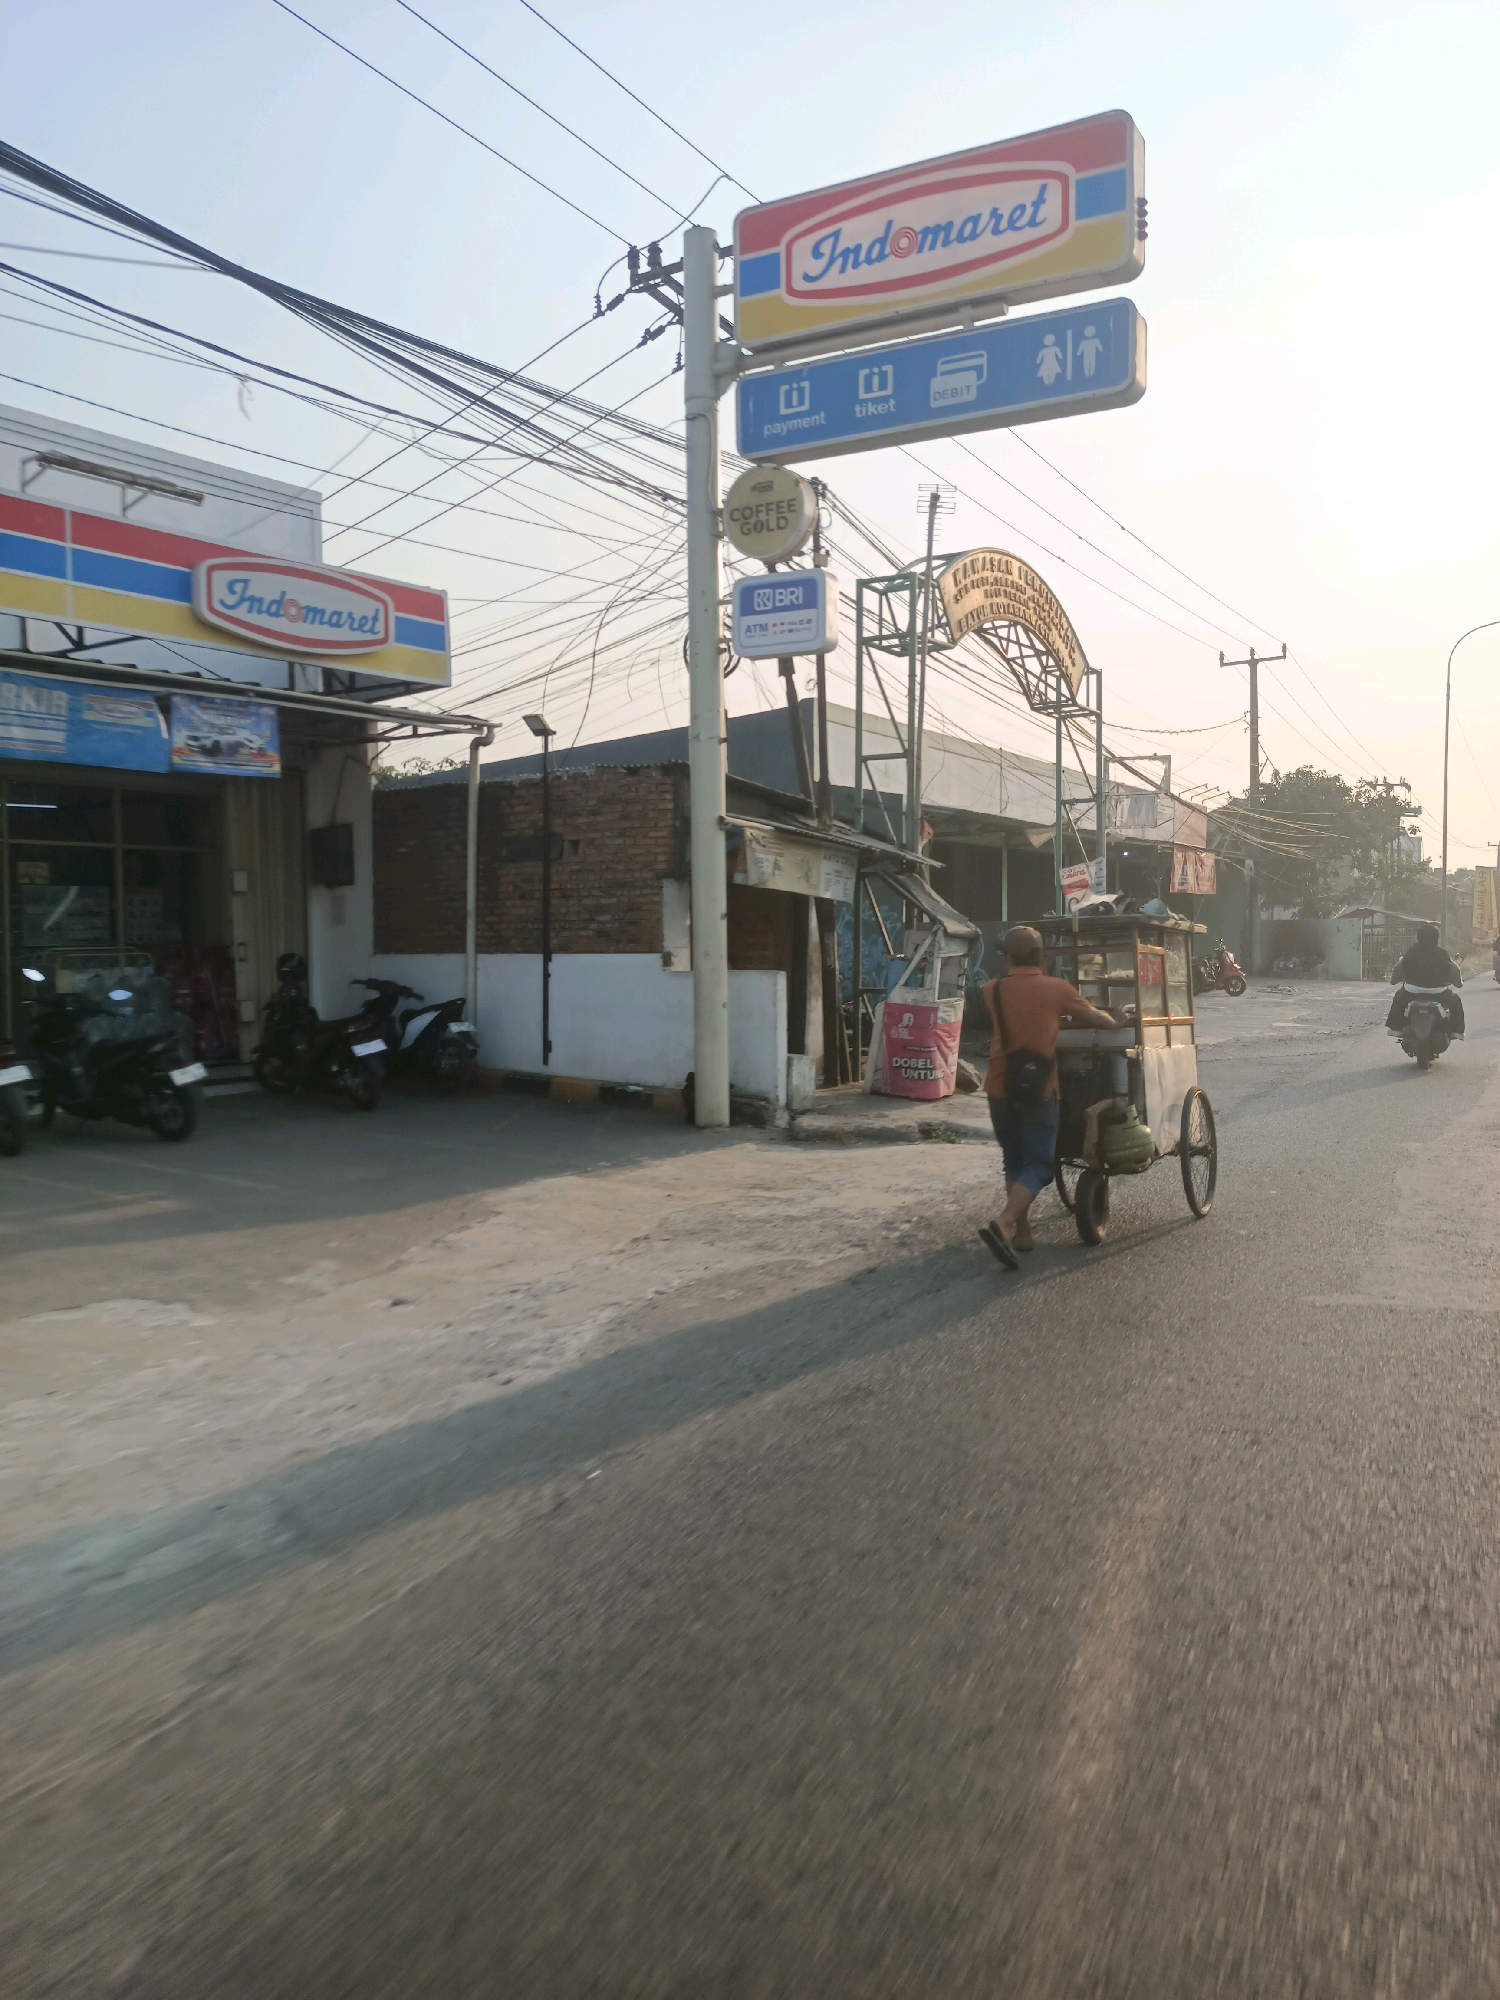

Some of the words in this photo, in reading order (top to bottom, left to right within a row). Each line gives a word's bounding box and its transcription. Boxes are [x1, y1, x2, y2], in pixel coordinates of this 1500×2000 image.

[802, 183, 1050, 283] Indomaret
[933, 384, 973, 402] DEBIT
[855, 398, 897, 418] tiket
[763, 411, 827, 438] payment
[729, 498, 798, 522] COFFEE
[740, 515, 790, 536] GOLD
[218, 578, 381, 636] Indomaret
[775, 586, 804, 607] BRI
[744, 622, 769, 635] ATM
[1477, 870, 1487, 925] GUMILAR
[892, 1057, 934, 1069] DOBEL
